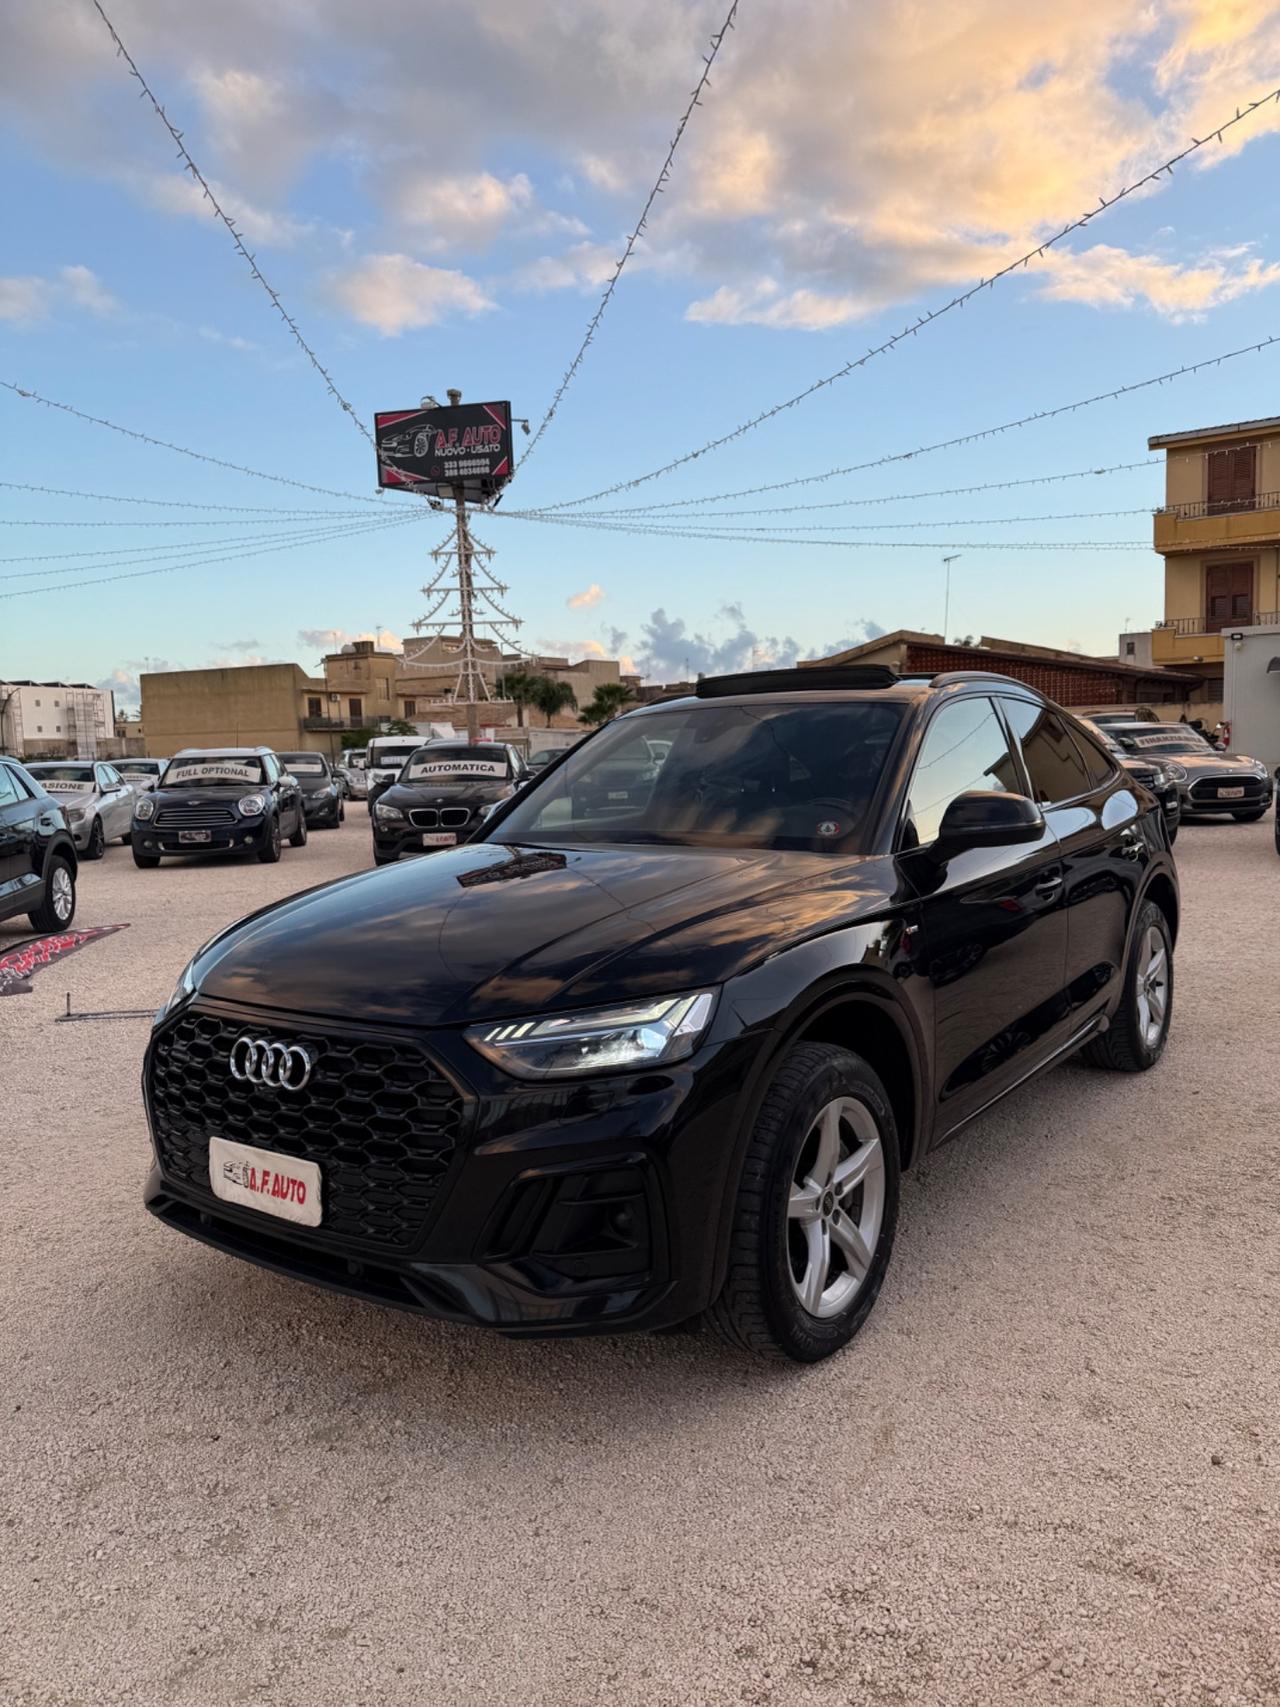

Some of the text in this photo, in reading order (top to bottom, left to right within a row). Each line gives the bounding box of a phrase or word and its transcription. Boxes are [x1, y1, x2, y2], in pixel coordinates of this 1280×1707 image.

[461, 424, 501, 447] AUTO
[176, 767, 249, 779] FULL OPTIONAL
[420, 763, 496, 774] AUTOMATICA
